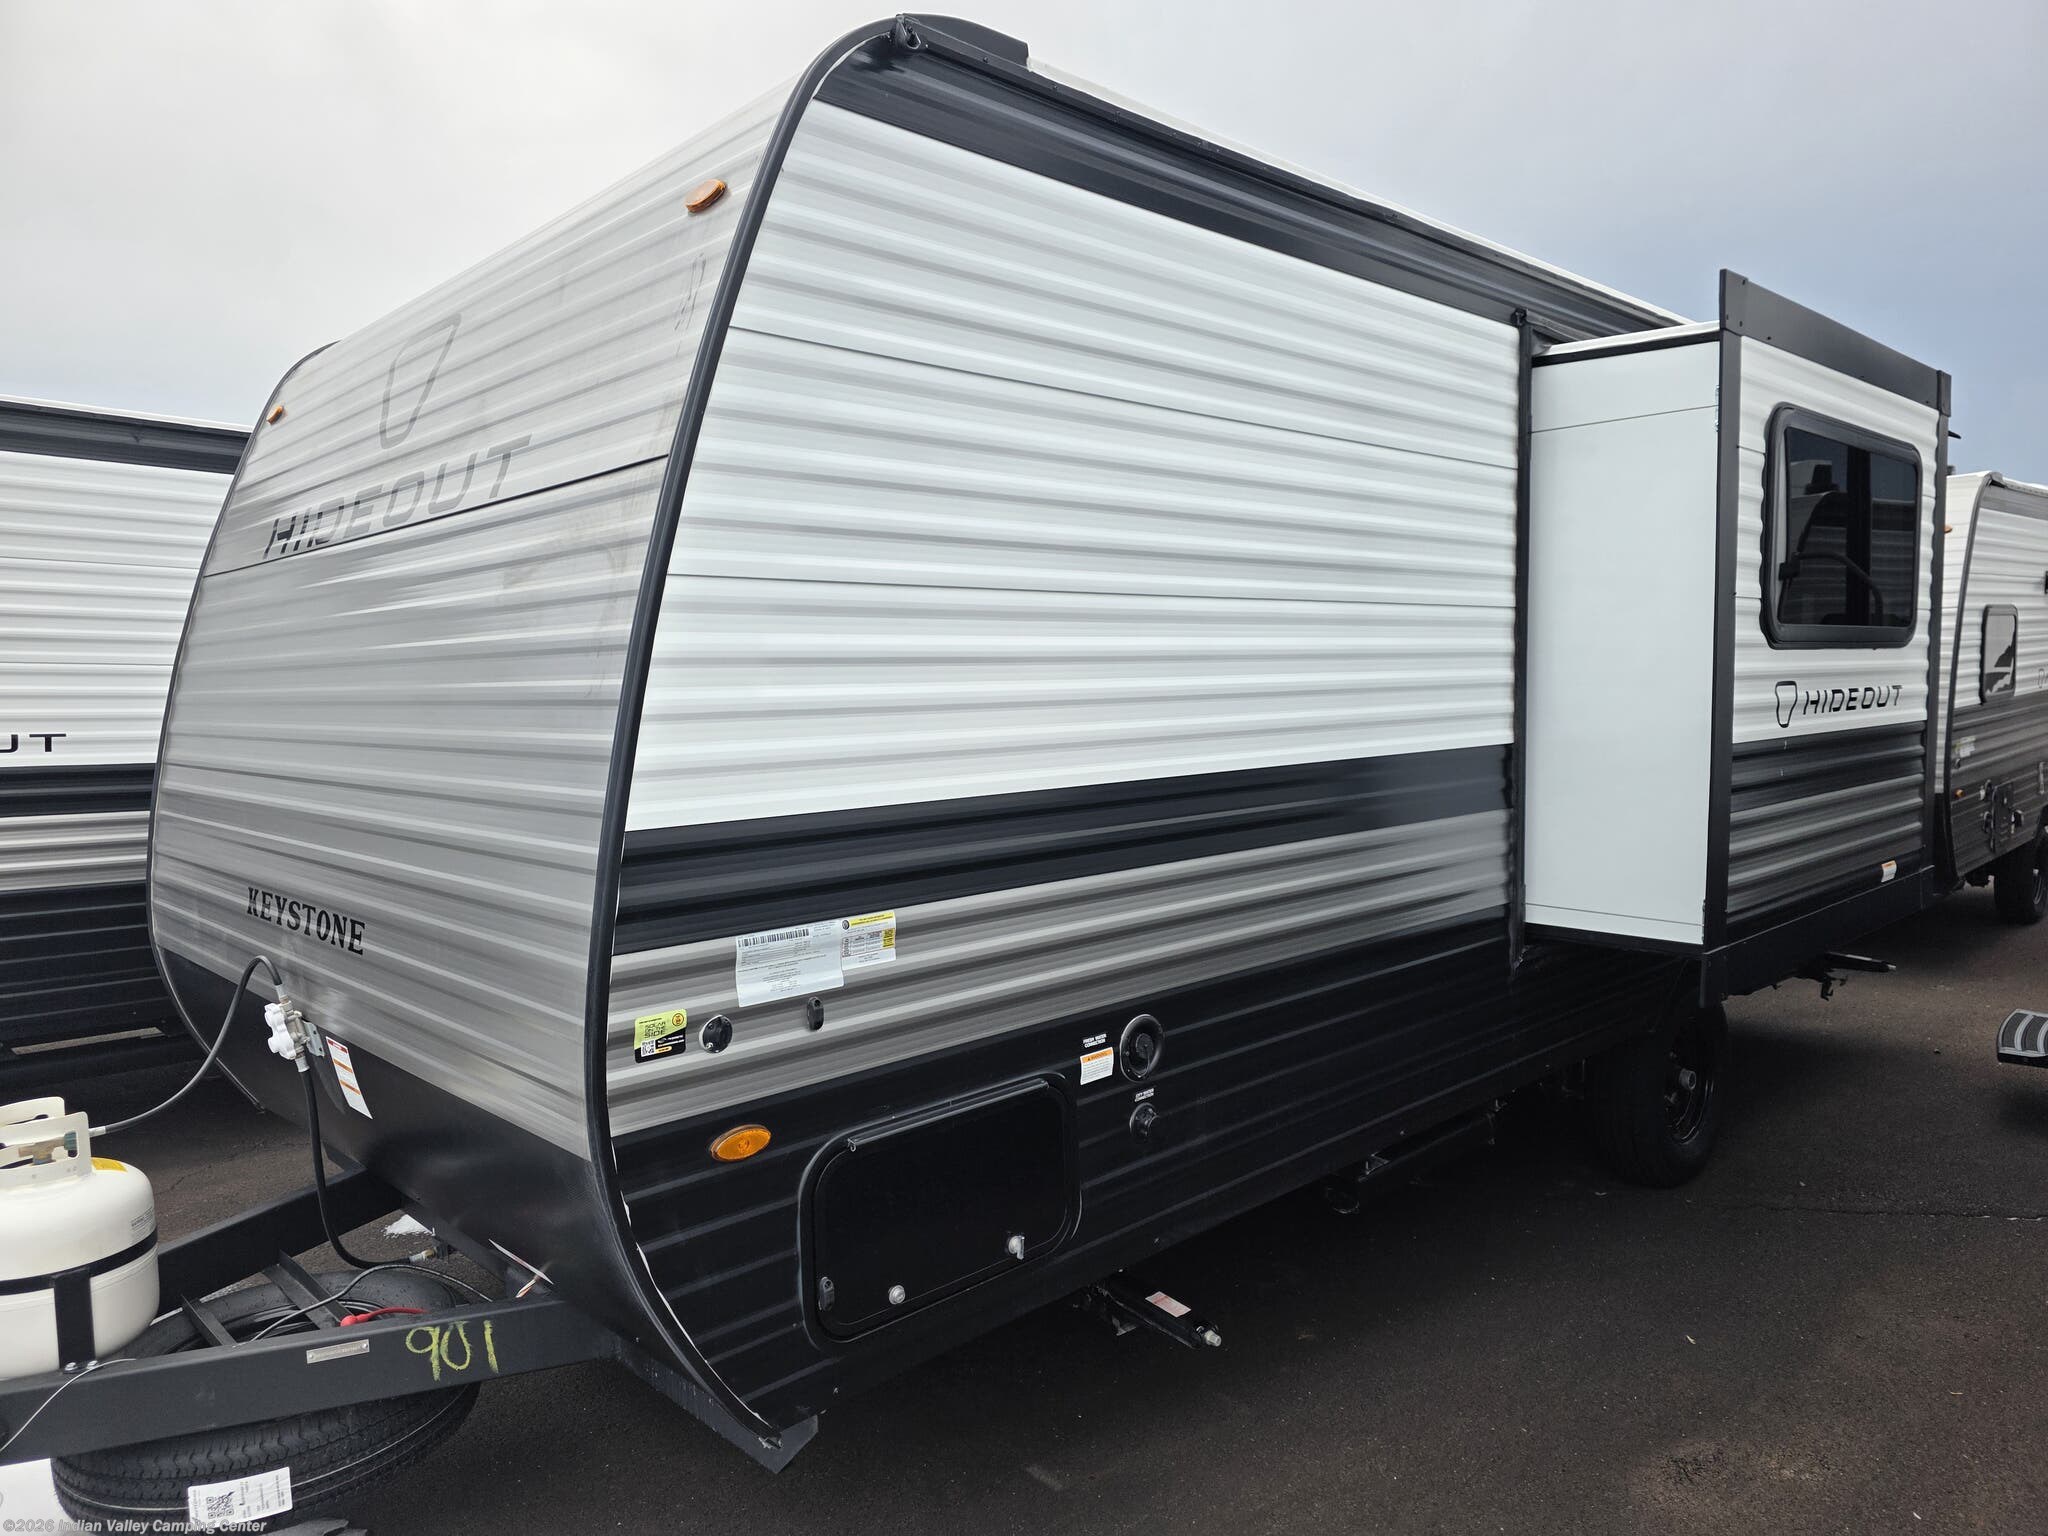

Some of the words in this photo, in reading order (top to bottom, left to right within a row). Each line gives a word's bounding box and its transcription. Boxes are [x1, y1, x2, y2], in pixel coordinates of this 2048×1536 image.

[263, 433, 532, 559] HIDEOUT
[1802, 684, 1902, 715] HIDEOUT
[247, 886, 366, 956] KEYSTONE
[405, 1320, 499, 1381] 901
